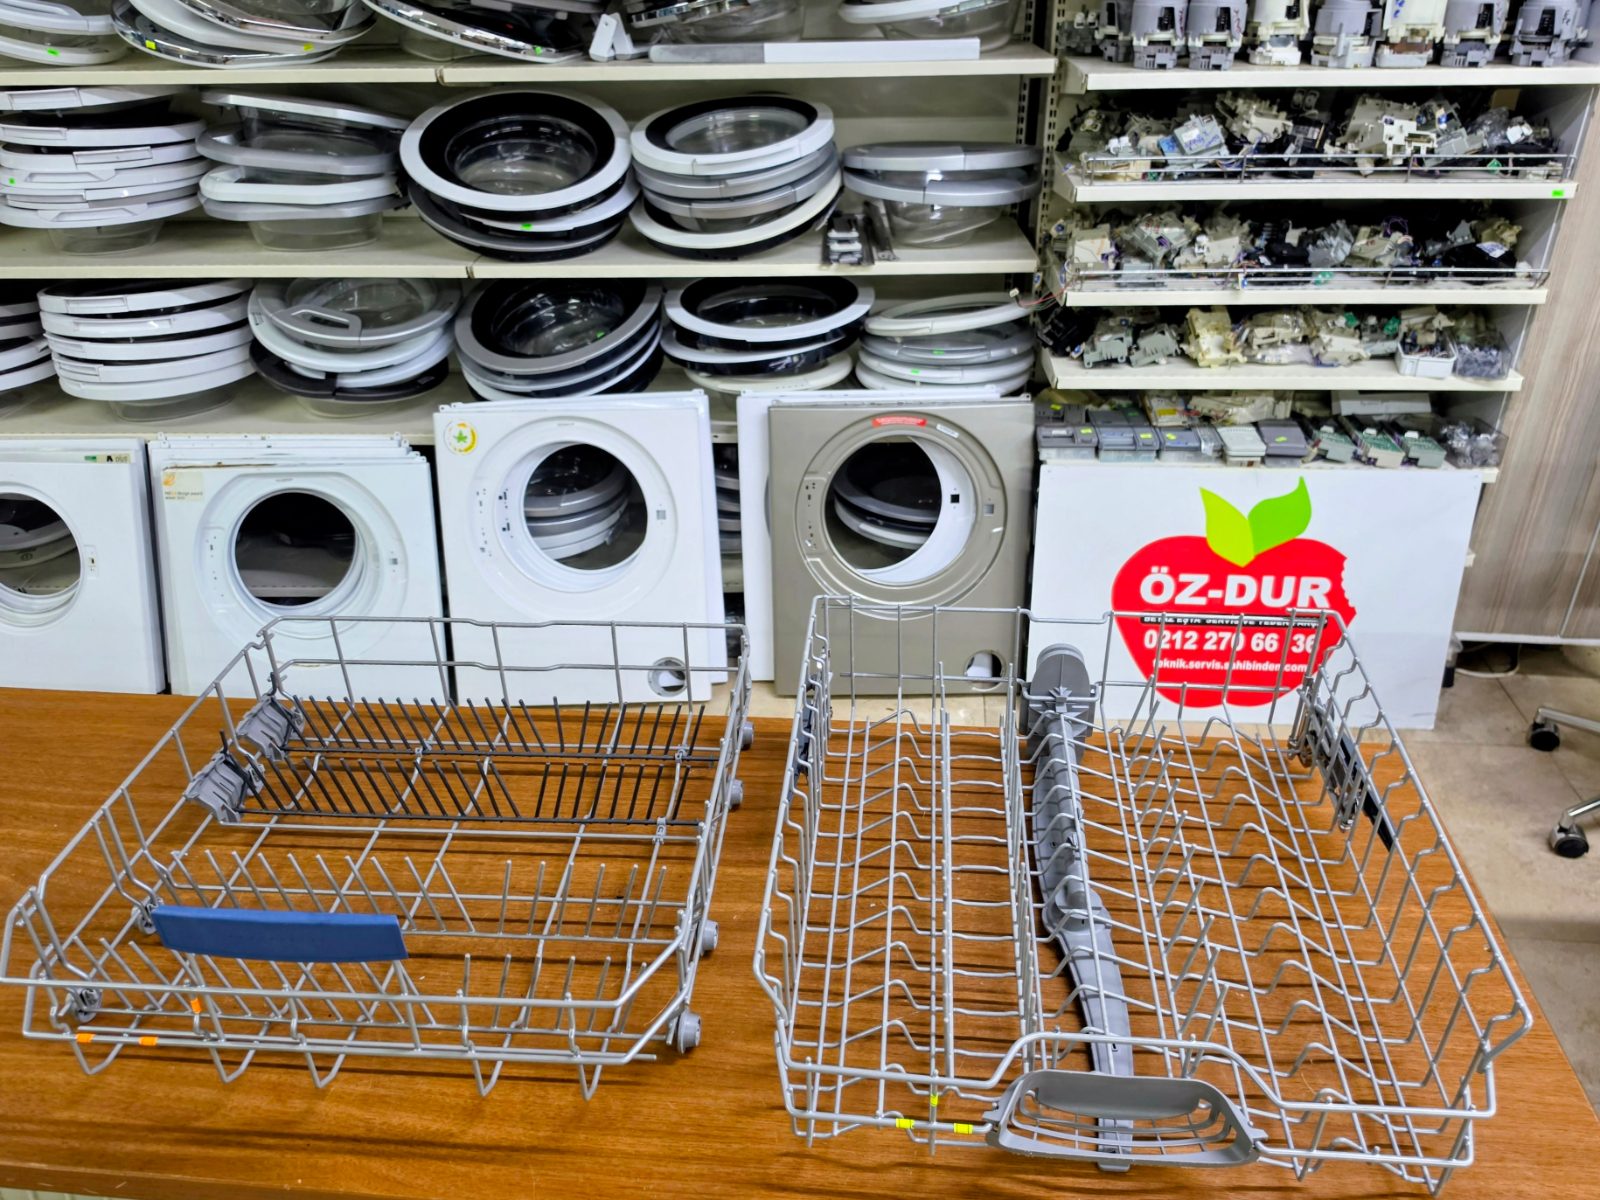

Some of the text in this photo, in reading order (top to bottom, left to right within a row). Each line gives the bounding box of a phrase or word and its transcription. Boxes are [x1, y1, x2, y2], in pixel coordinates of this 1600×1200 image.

[1140, 566, 1332, 608] ÖZ-DUR
[1143, 629, 1318, 653] 0212 270 66 36
